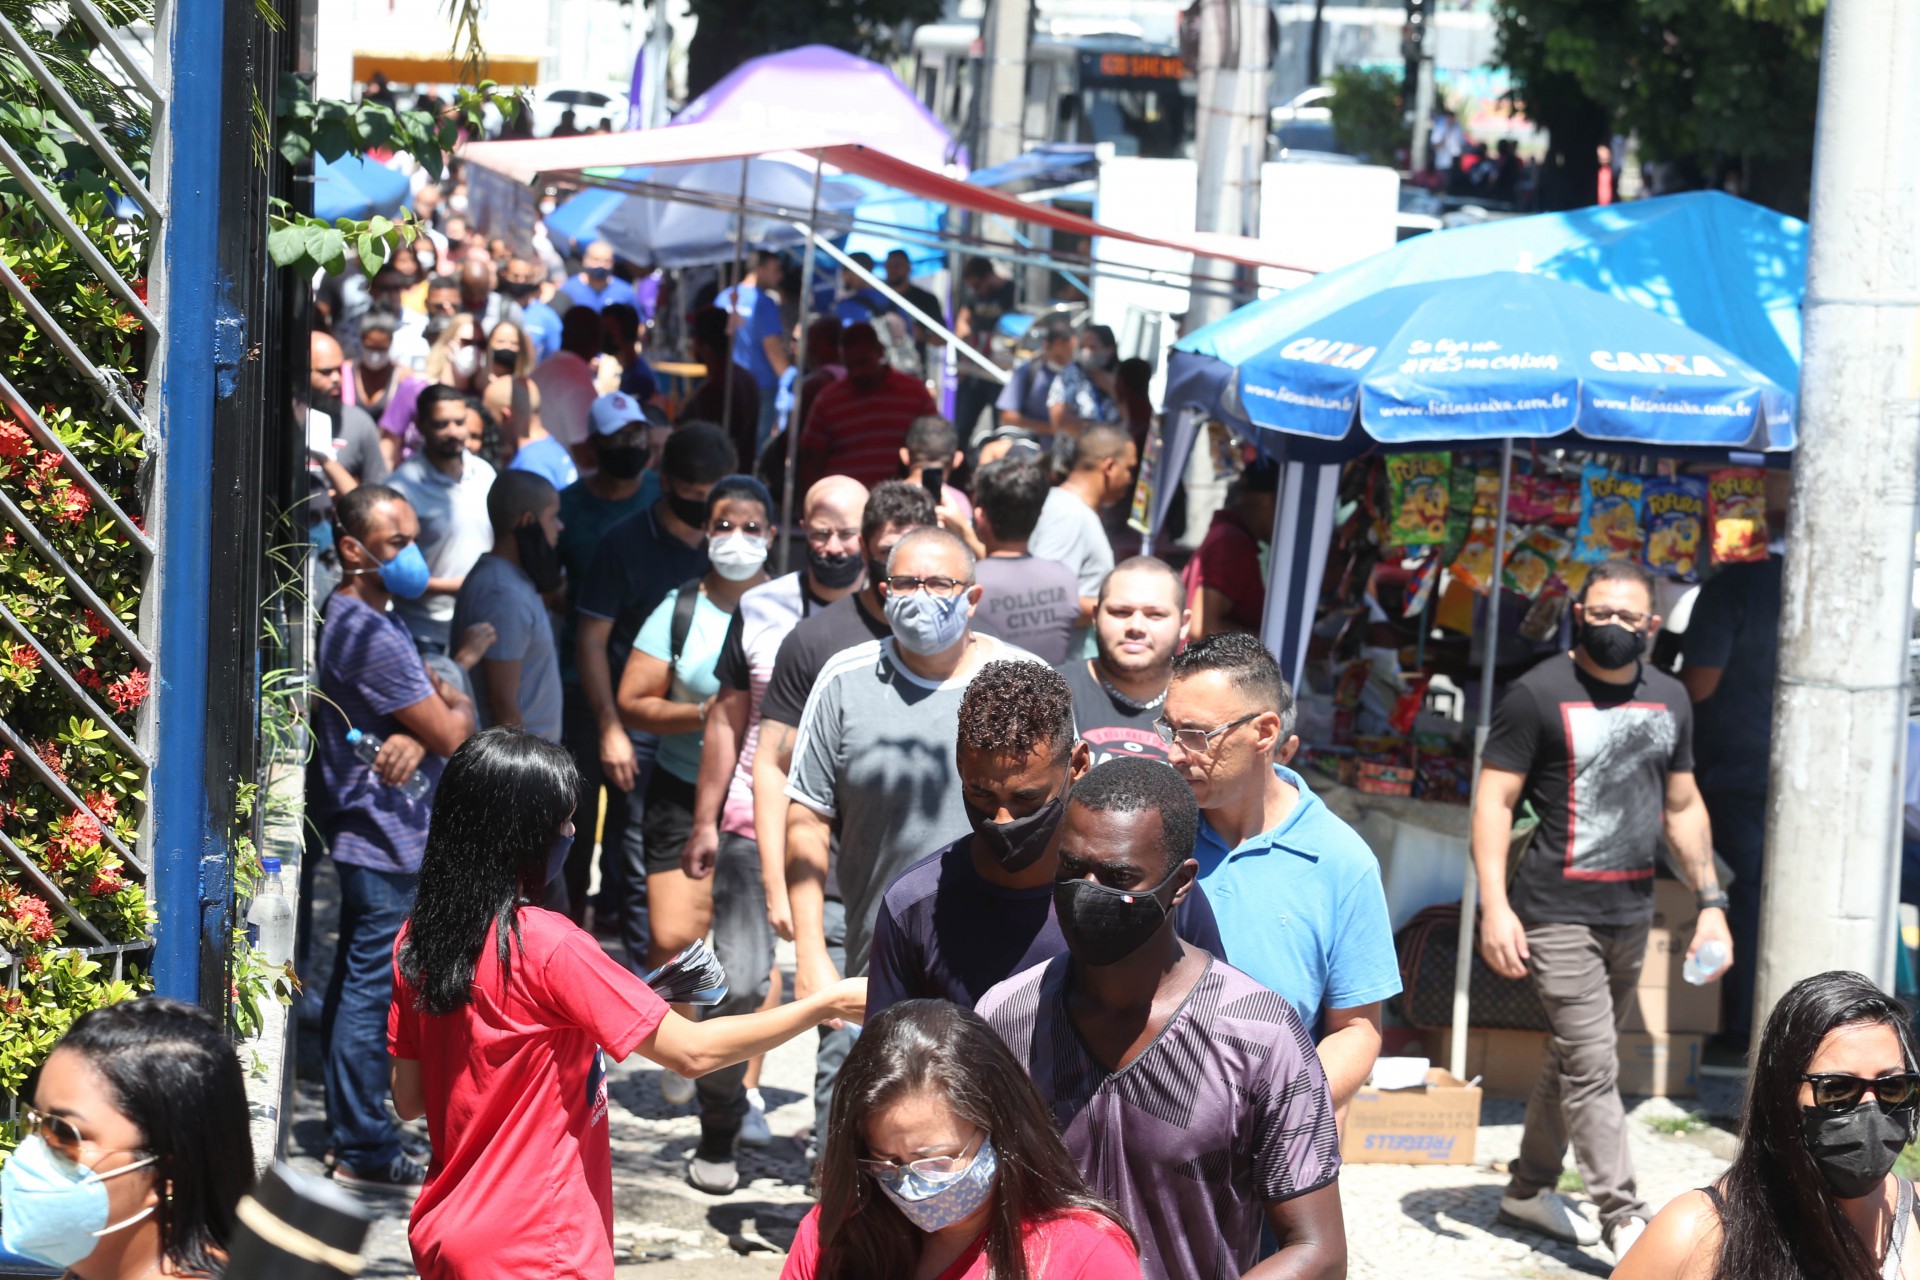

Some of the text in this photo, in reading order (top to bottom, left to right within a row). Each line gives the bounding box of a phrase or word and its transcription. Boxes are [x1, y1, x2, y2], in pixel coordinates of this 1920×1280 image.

[1280, 338, 1376, 370] CAIXA
[1590, 351, 1726, 377] CAIXA
[1379, 393, 1569, 417] www.fiesnacaixa.com.br
[1593, 395, 1751, 416] www.fiesnacaixa.com.br
[1006, 608, 1055, 630] CIVIL
[1364, 1134, 1455, 1151] FREEGELLS
